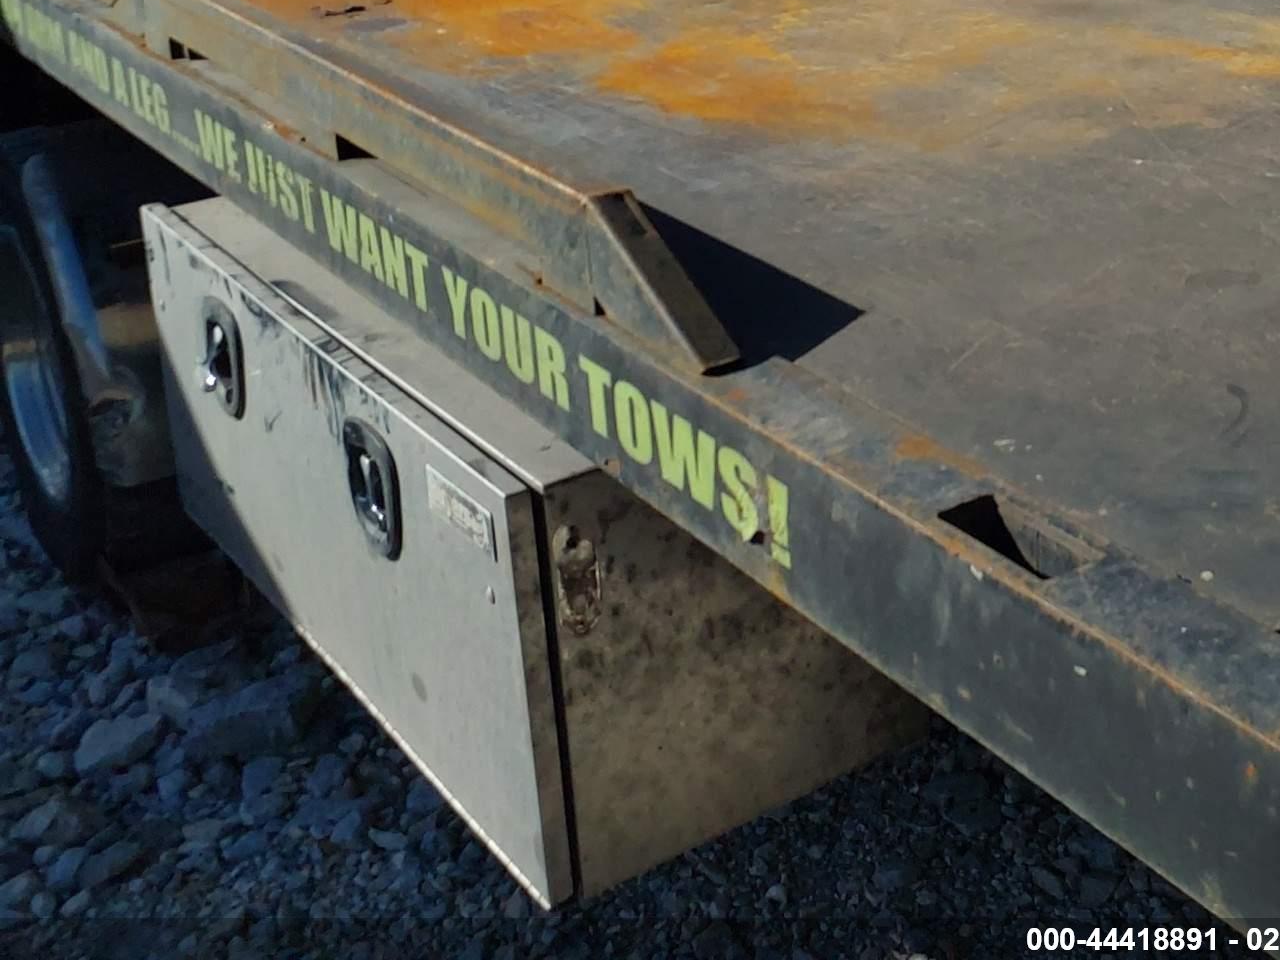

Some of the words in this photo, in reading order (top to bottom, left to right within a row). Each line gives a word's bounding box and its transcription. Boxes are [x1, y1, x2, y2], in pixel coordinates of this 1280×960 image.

[320, 188, 429, 313] WANT
[442, 264, 570, 413] YOUR
[578, 353, 792, 571] TOWS!
